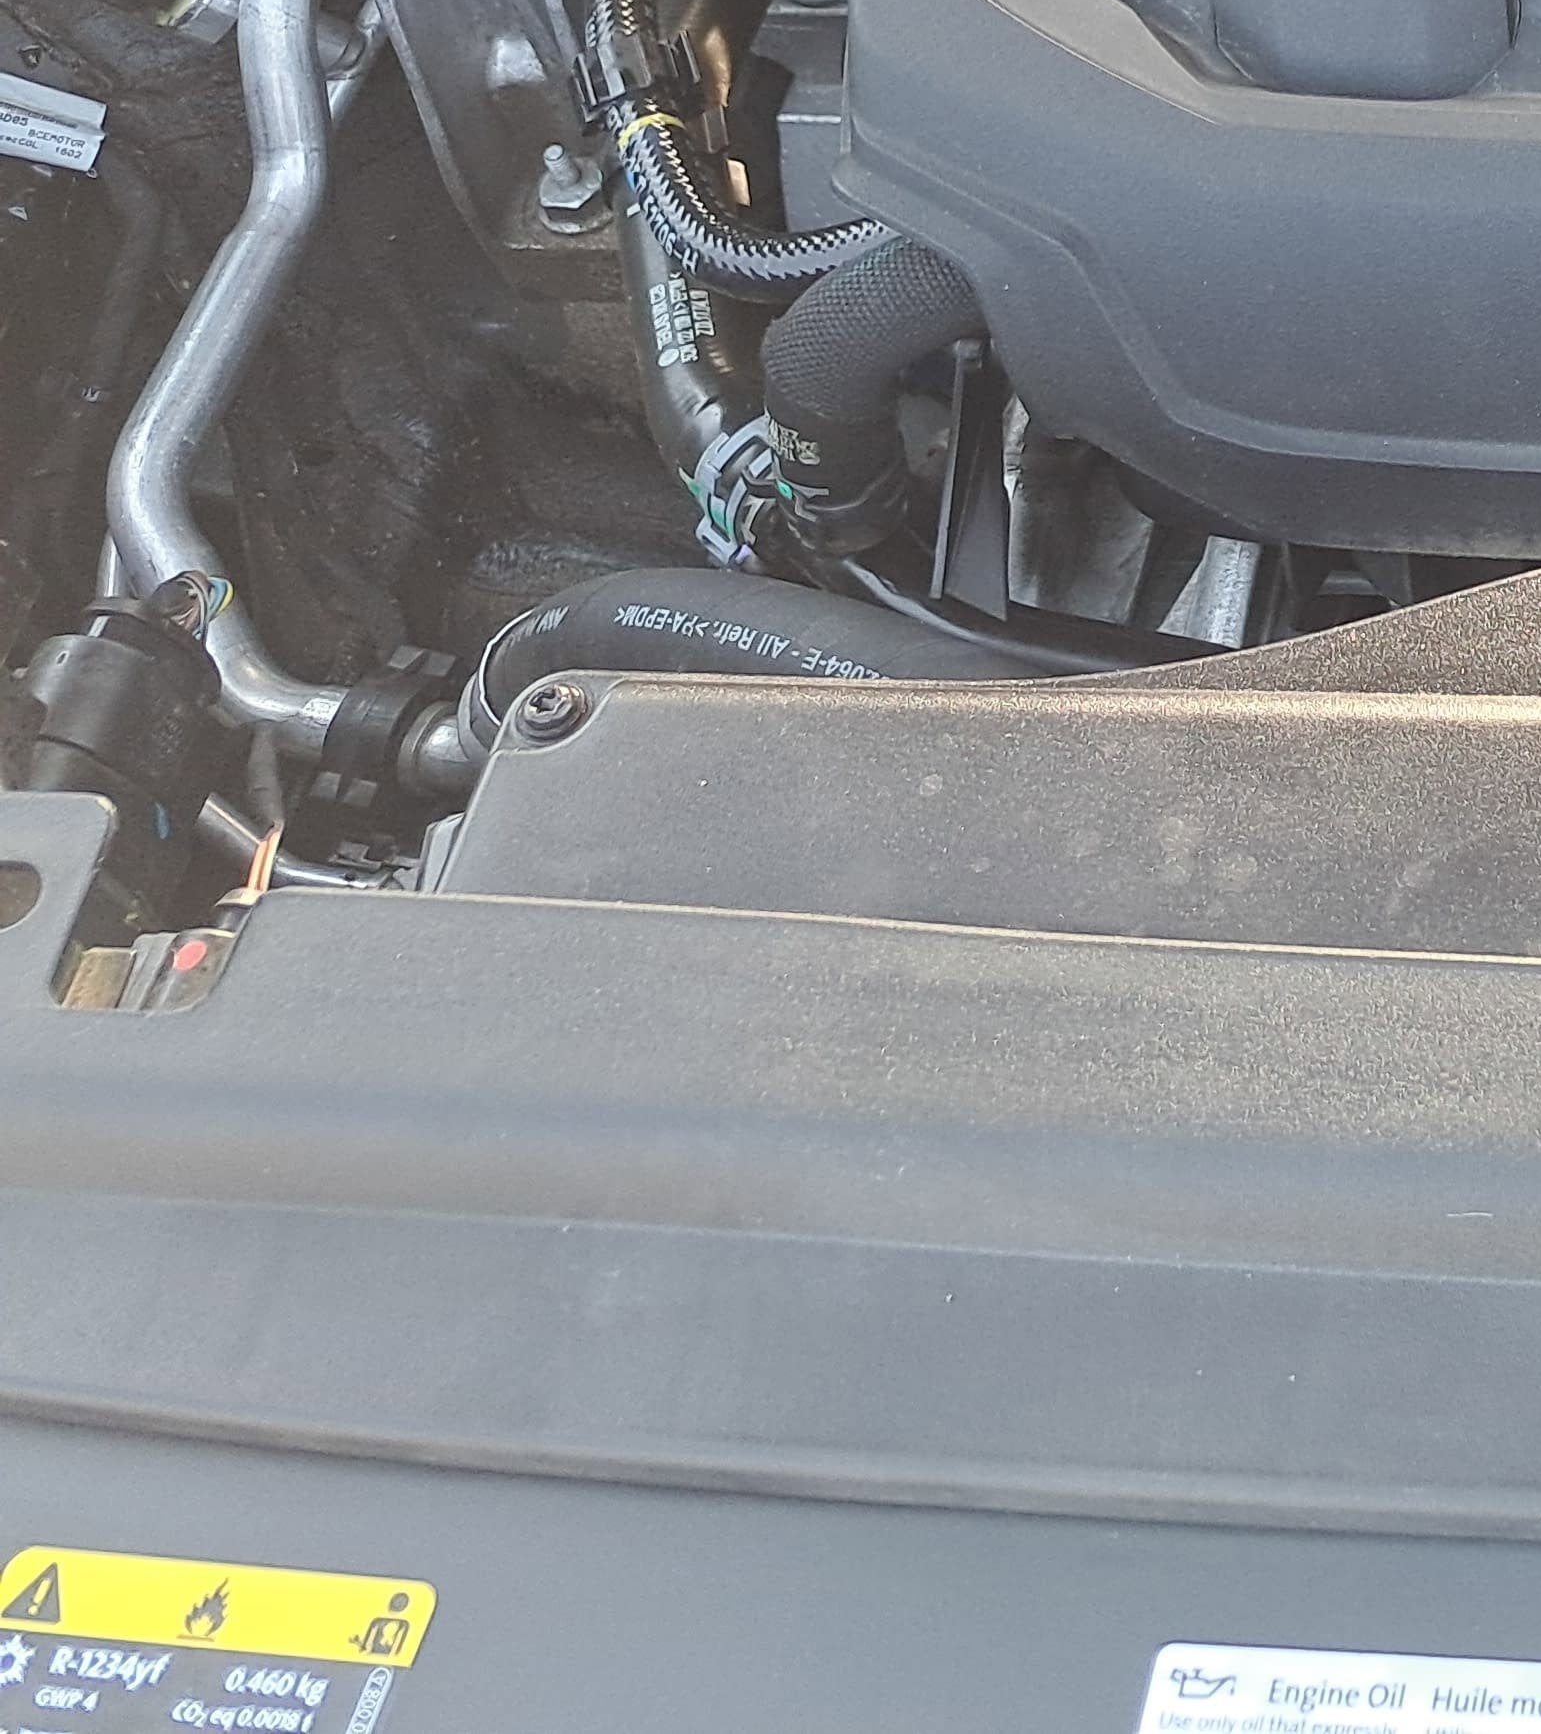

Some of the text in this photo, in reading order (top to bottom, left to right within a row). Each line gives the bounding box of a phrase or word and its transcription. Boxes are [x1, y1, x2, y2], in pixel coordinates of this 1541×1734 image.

[613, 604, 707, 638] >PA-EPDM<
[713, 618, 757, 651] Refr.
[756, 631, 792, 659] All
[49, 1645, 174, 1692] R-1234yf
[34, 1686, 101, 1713] GWP 4
[225, 1665, 330, 1707] 0.460 kg
[1267, 1678, 1407, 1712] Engine Oil
[1431, 1685, 1504, 1717] Huile
[1158, 1711, 1192, 1730] Use
[1198, 1713, 1237, 1734] only
[1241, 1713, 1265, 1733] oil
[1268, 1716, 1307, 1734] that
